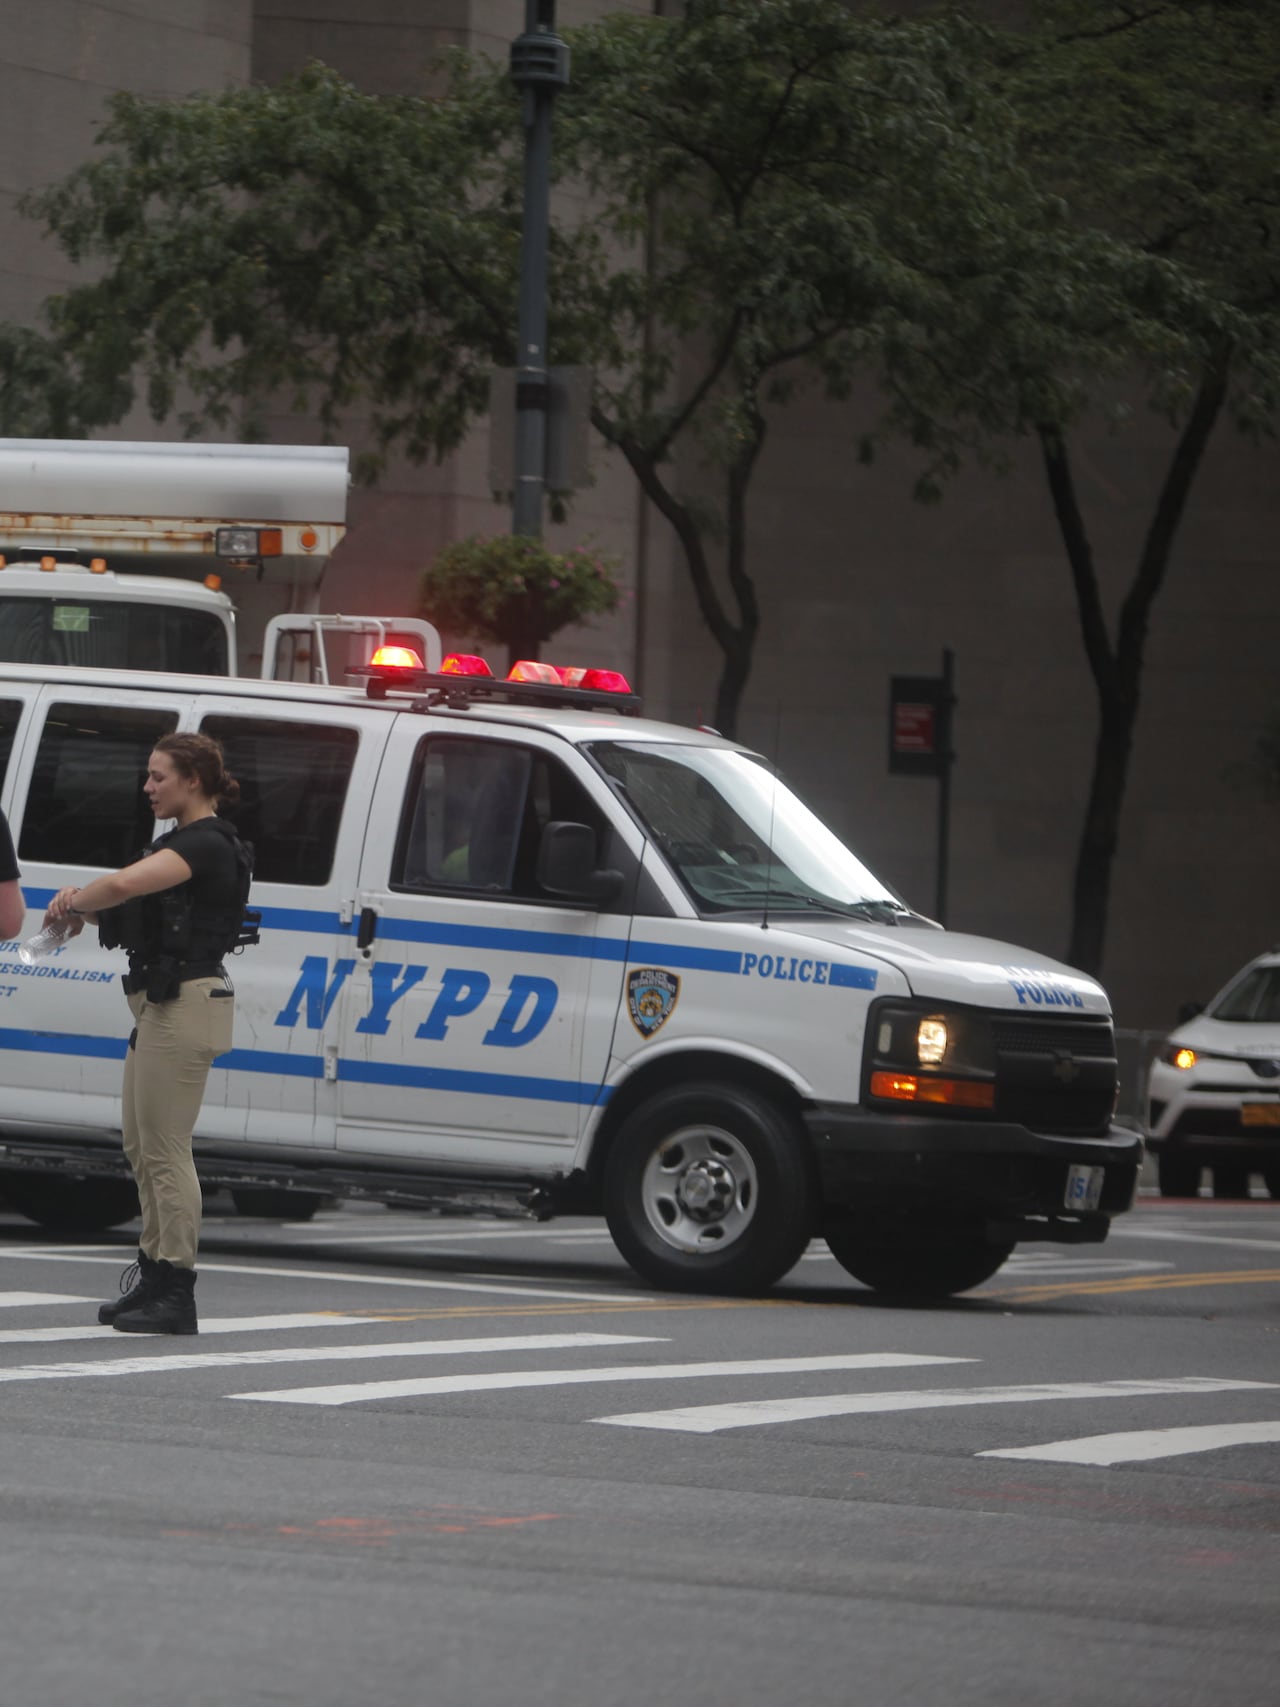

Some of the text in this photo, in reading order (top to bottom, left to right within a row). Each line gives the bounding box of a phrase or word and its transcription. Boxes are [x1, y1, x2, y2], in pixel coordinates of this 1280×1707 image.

[742, 952, 828, 985] POLICE
[274, 955, 559, 1048] NYPD
[1008, 980, 1084, 1009] POLICE
